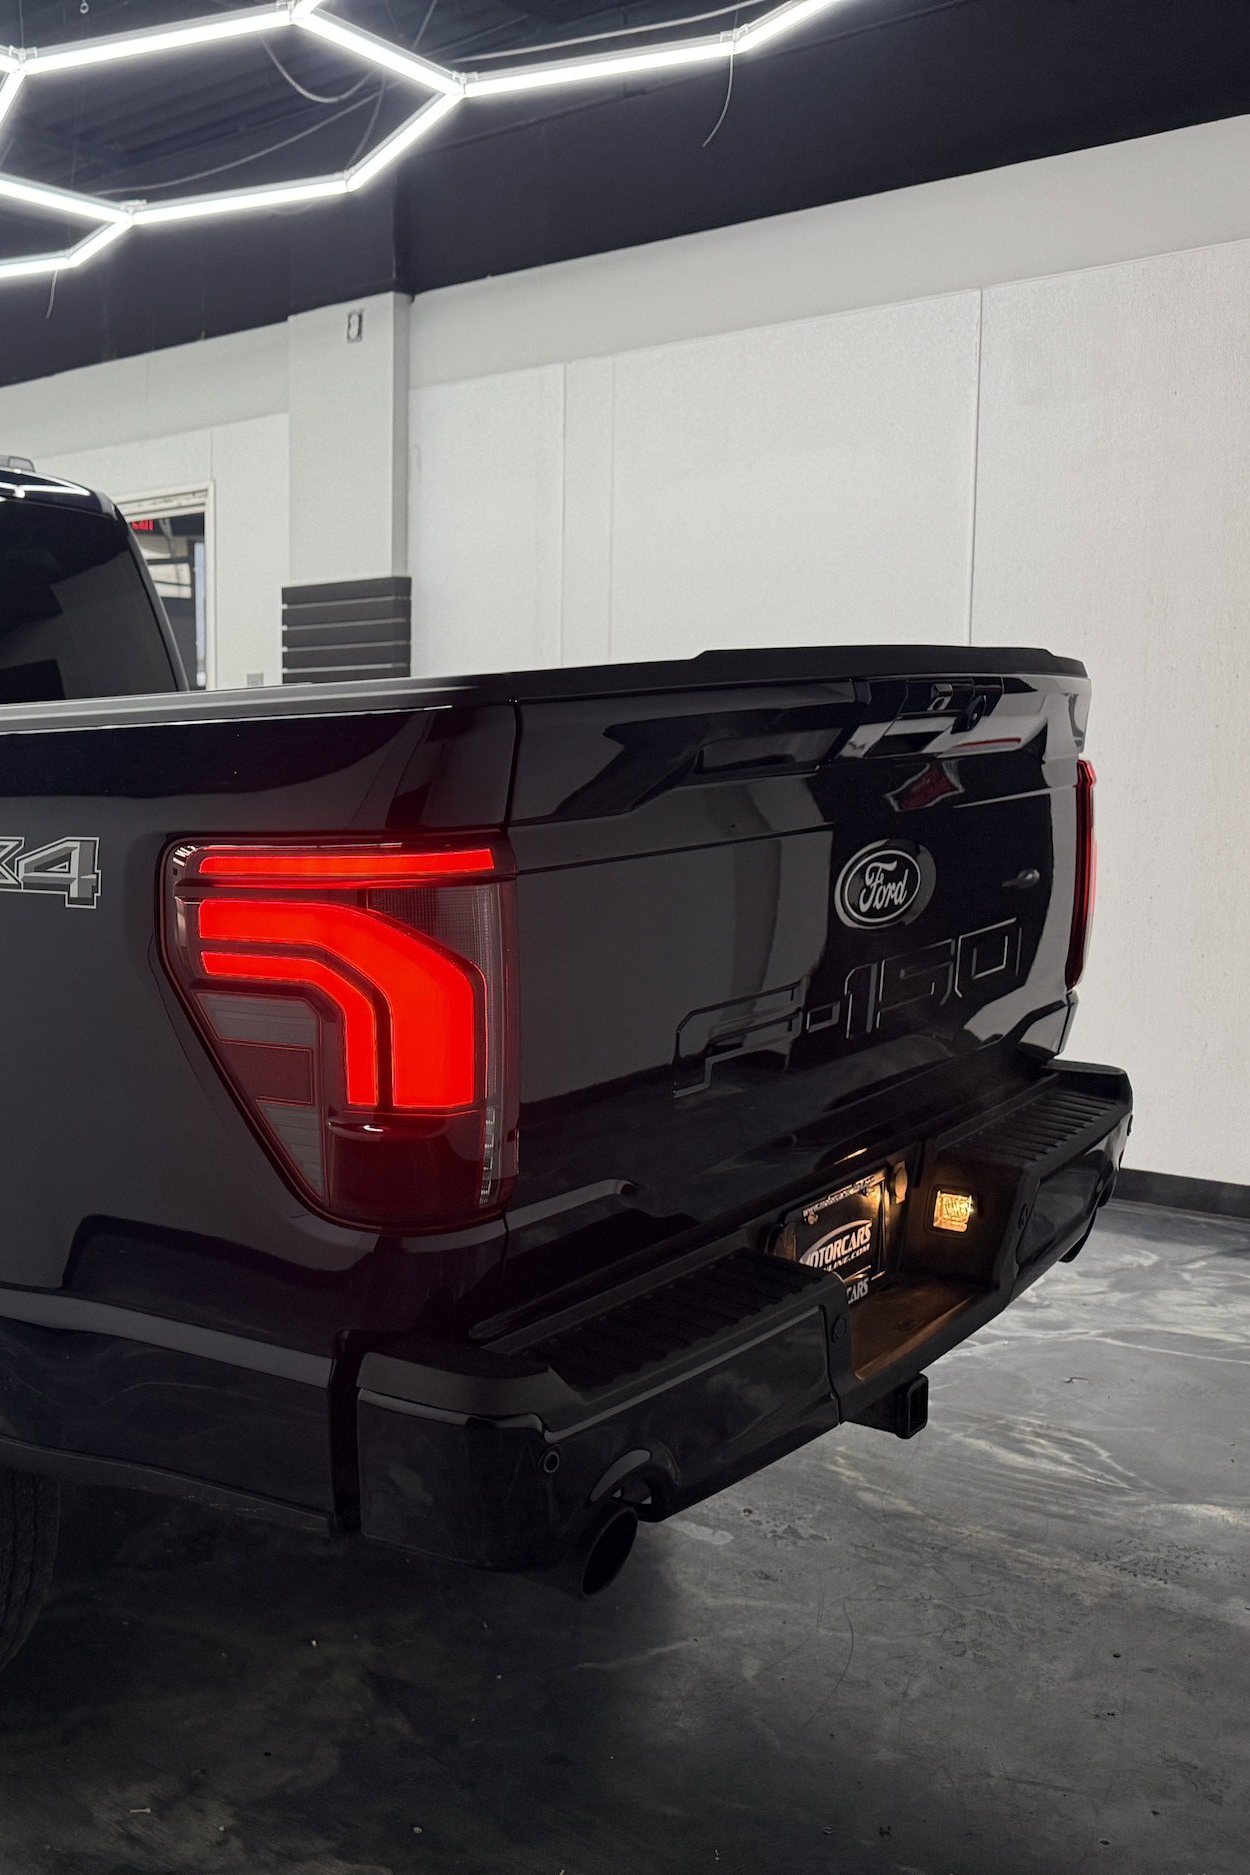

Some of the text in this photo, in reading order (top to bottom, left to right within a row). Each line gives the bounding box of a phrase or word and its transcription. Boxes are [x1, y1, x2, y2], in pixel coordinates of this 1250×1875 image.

[859, 860, 910, 913] Ford
[672, 916, 1023, 1098] F-150
[806, 1222, 873, 1268] OTORCARS
